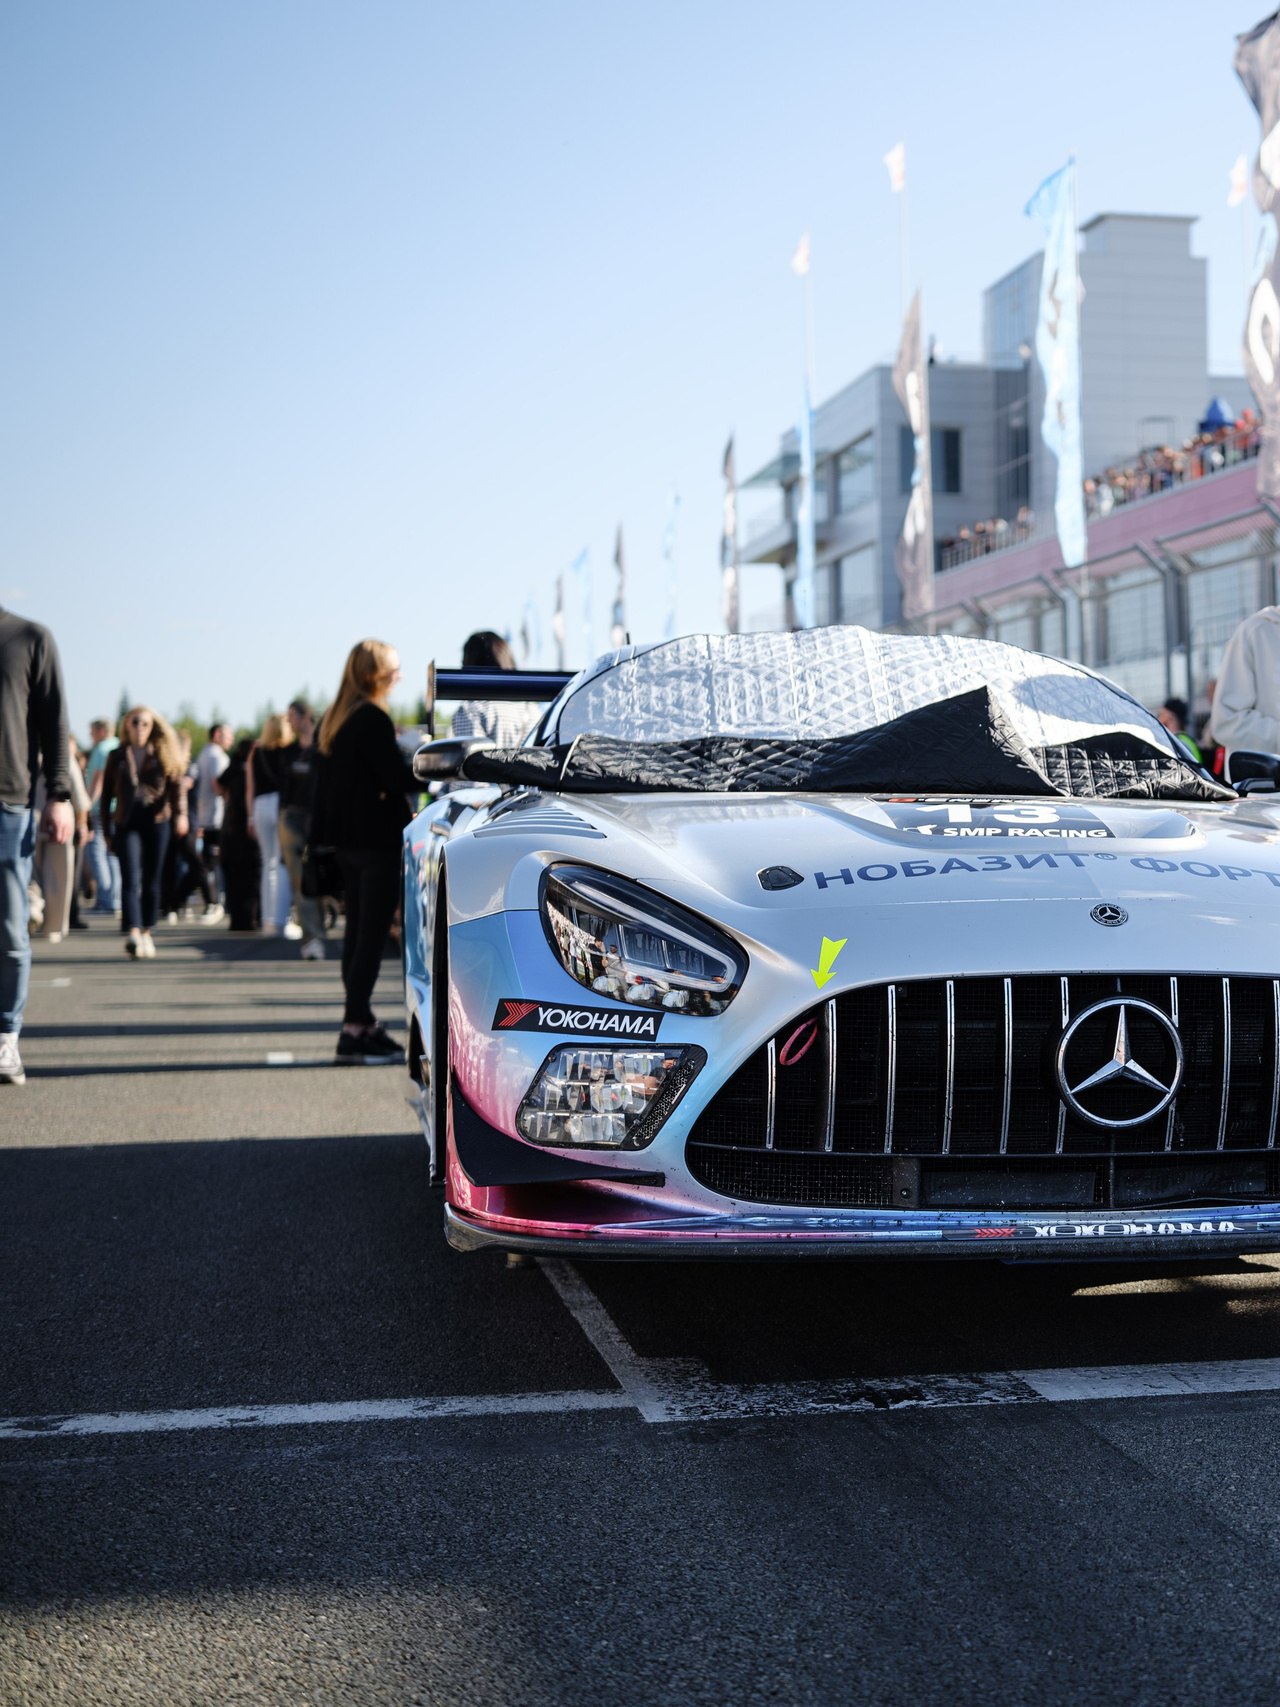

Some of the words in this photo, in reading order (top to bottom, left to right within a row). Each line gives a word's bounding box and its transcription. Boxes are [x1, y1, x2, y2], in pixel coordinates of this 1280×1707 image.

[915, 804, 1061, 824] 13
[943, 827, 1002, 837] SMP
[1007, 828, 1108, 838] RACING
[537, 1006, 656, 1036] YOKOHAMA
